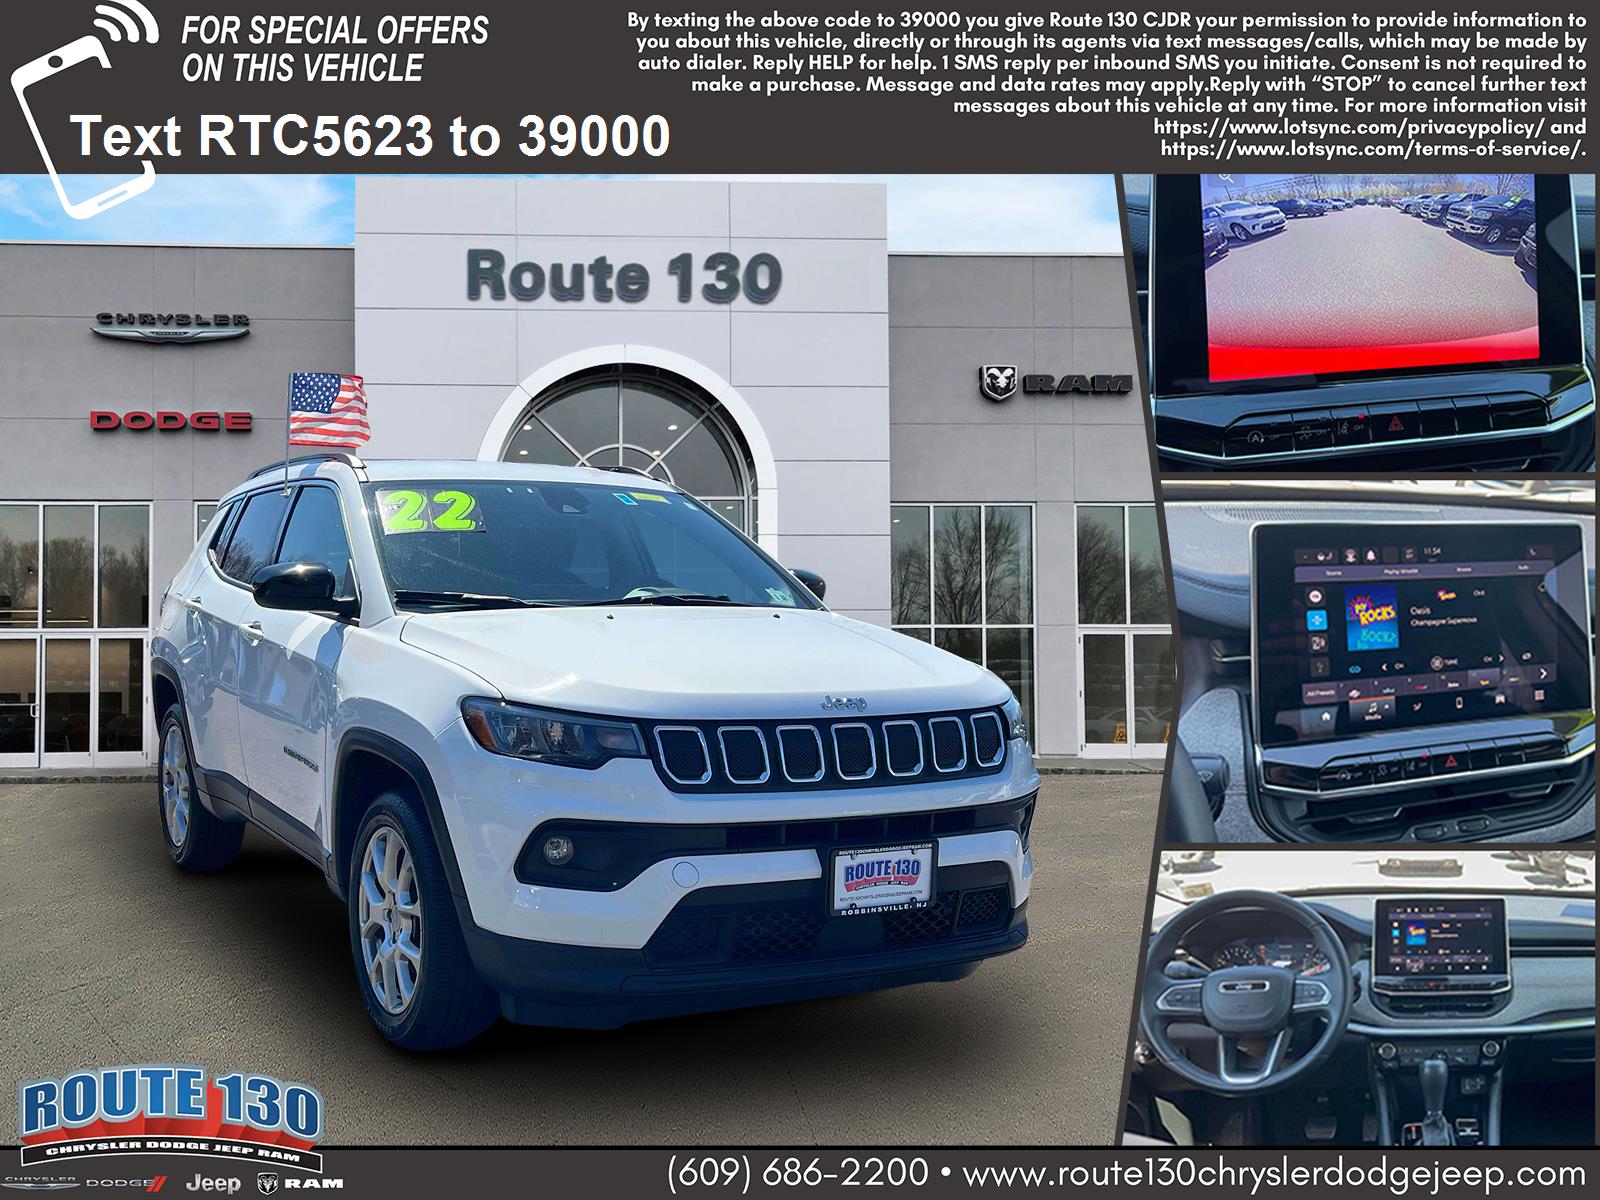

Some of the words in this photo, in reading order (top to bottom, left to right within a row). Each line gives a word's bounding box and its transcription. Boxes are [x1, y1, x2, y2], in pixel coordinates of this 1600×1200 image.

[467, 248, 650, 302] Route
[667, 251, 783, 304] 130
[96, 312, 250, 326] CHRYSLER
[1022, 374, 1133, 394] RAM
[89, 411, 252, 432] DODGE
[384, 489, 476, 531] 22
[820, 694, 867, 713] Jeep
[845, 860, 891, 882] ROUTE
[894, 859, 920, 876] 130
